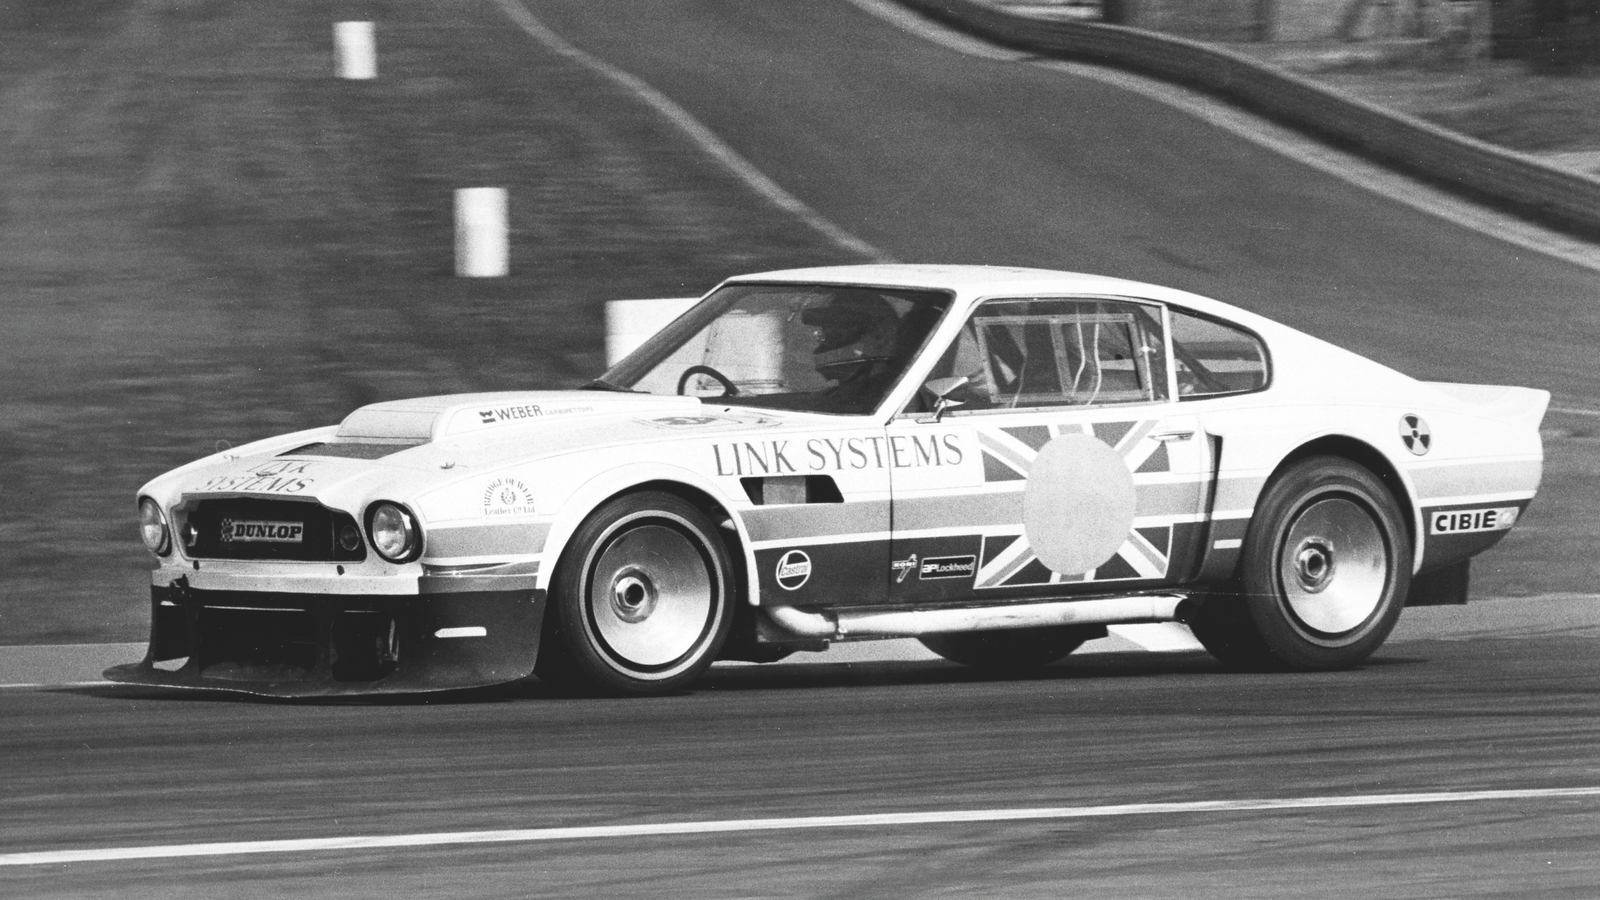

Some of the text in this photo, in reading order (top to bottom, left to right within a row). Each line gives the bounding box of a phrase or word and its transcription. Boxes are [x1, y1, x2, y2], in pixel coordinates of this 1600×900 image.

[495, 405, 543, 421] WEBER
[711, 433, 963, 477] LINK SYSTEMS
[483, 478, 503, 506] BRIDGE
[234, 524, 302, 539] DUNLOP
